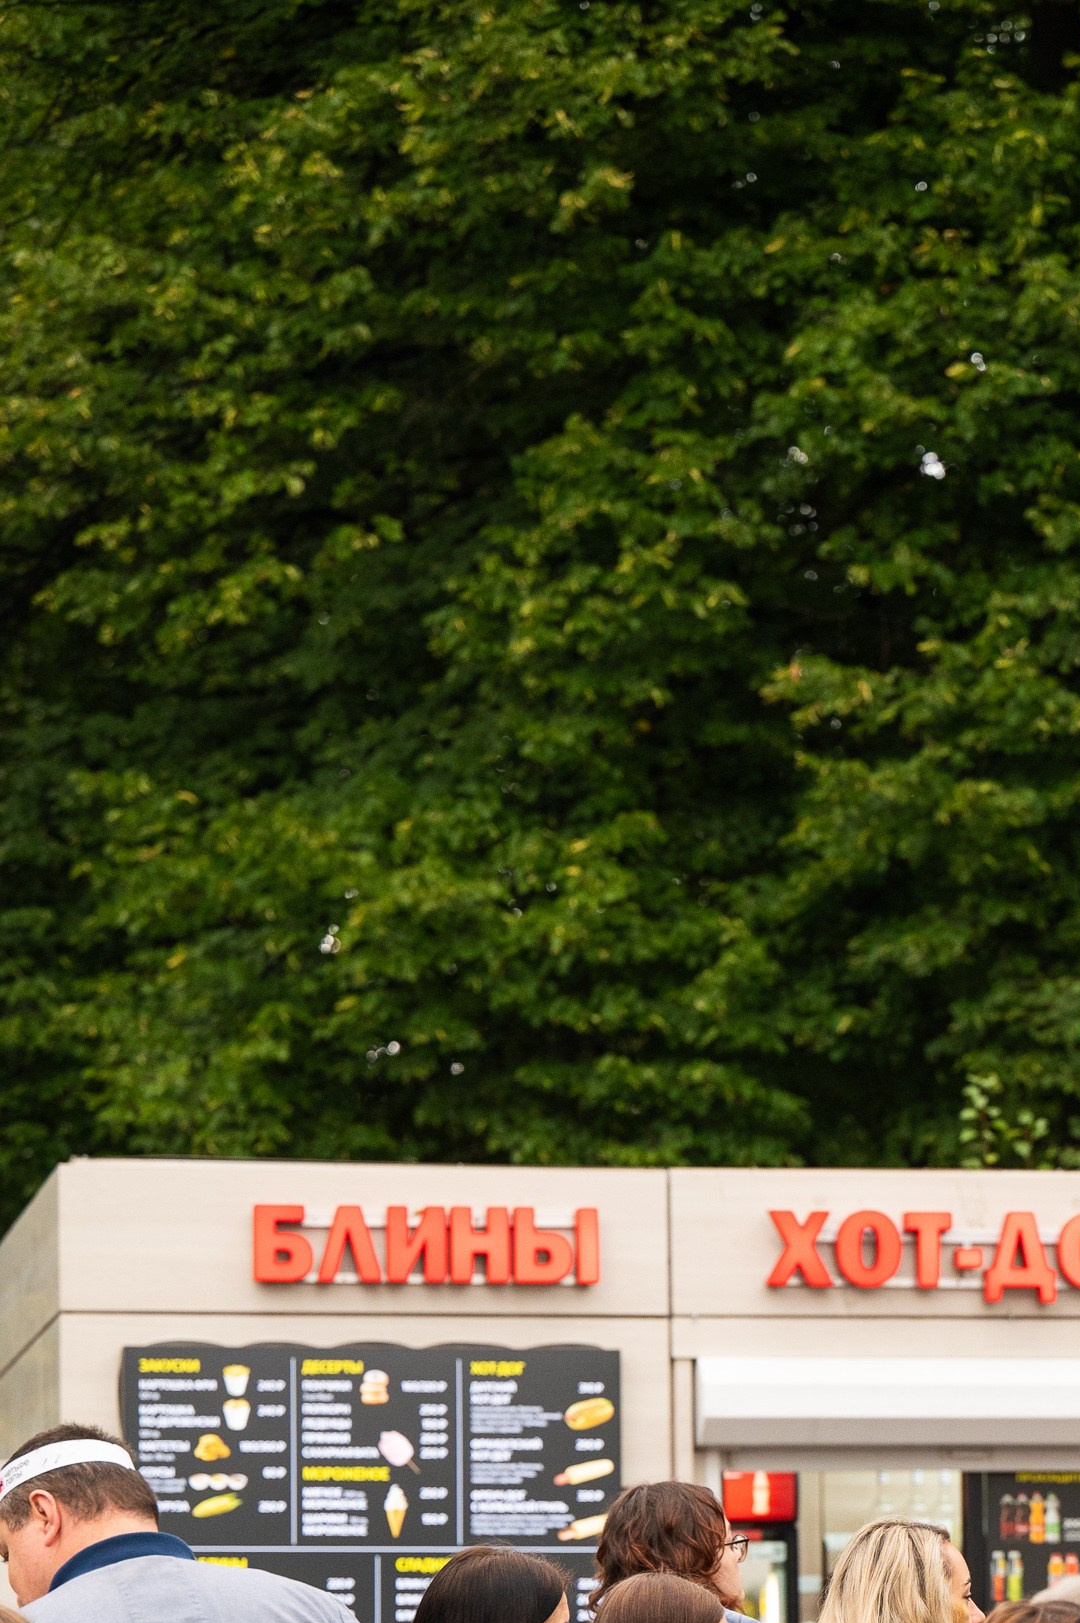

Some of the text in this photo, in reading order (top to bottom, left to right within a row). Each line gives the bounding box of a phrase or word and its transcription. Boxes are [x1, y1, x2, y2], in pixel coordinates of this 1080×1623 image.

[253, 1205, 599, 1285] БЛИНЫ
[301, 1359, 364, 1375] ДЕСЕРТЫ
[302, 1466, 390, 1481] МОРОЖЕНОЕ
